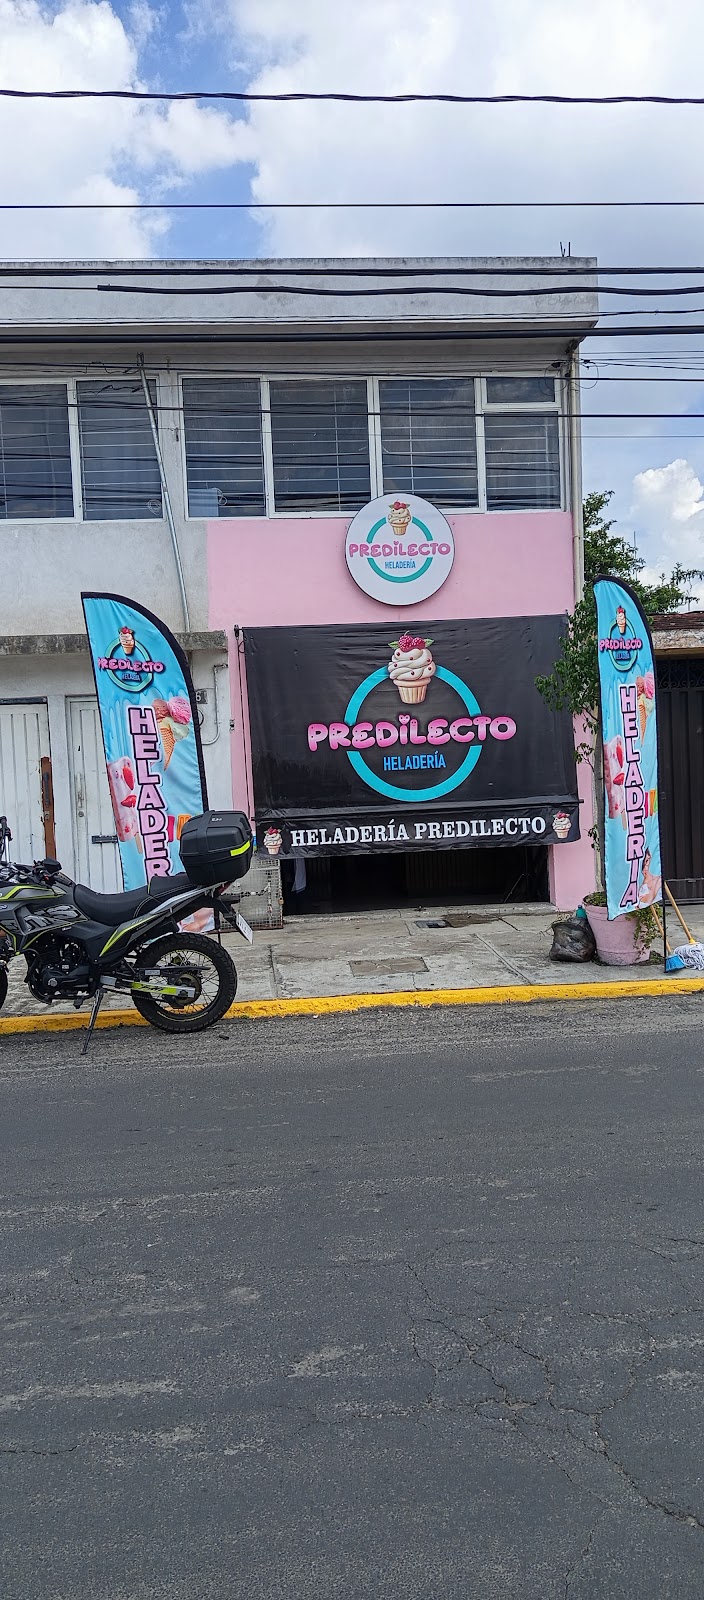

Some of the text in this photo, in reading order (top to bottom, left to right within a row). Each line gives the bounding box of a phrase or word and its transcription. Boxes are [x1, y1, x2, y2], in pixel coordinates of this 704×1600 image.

[384, 558, 416, 569] HELADERÍA
[383, 750, 446, 771] HELADERÍA
[128, 707, 171, 884] HELADER
[290, 817, 546, 847] HELADERÍA PREDILECTO
